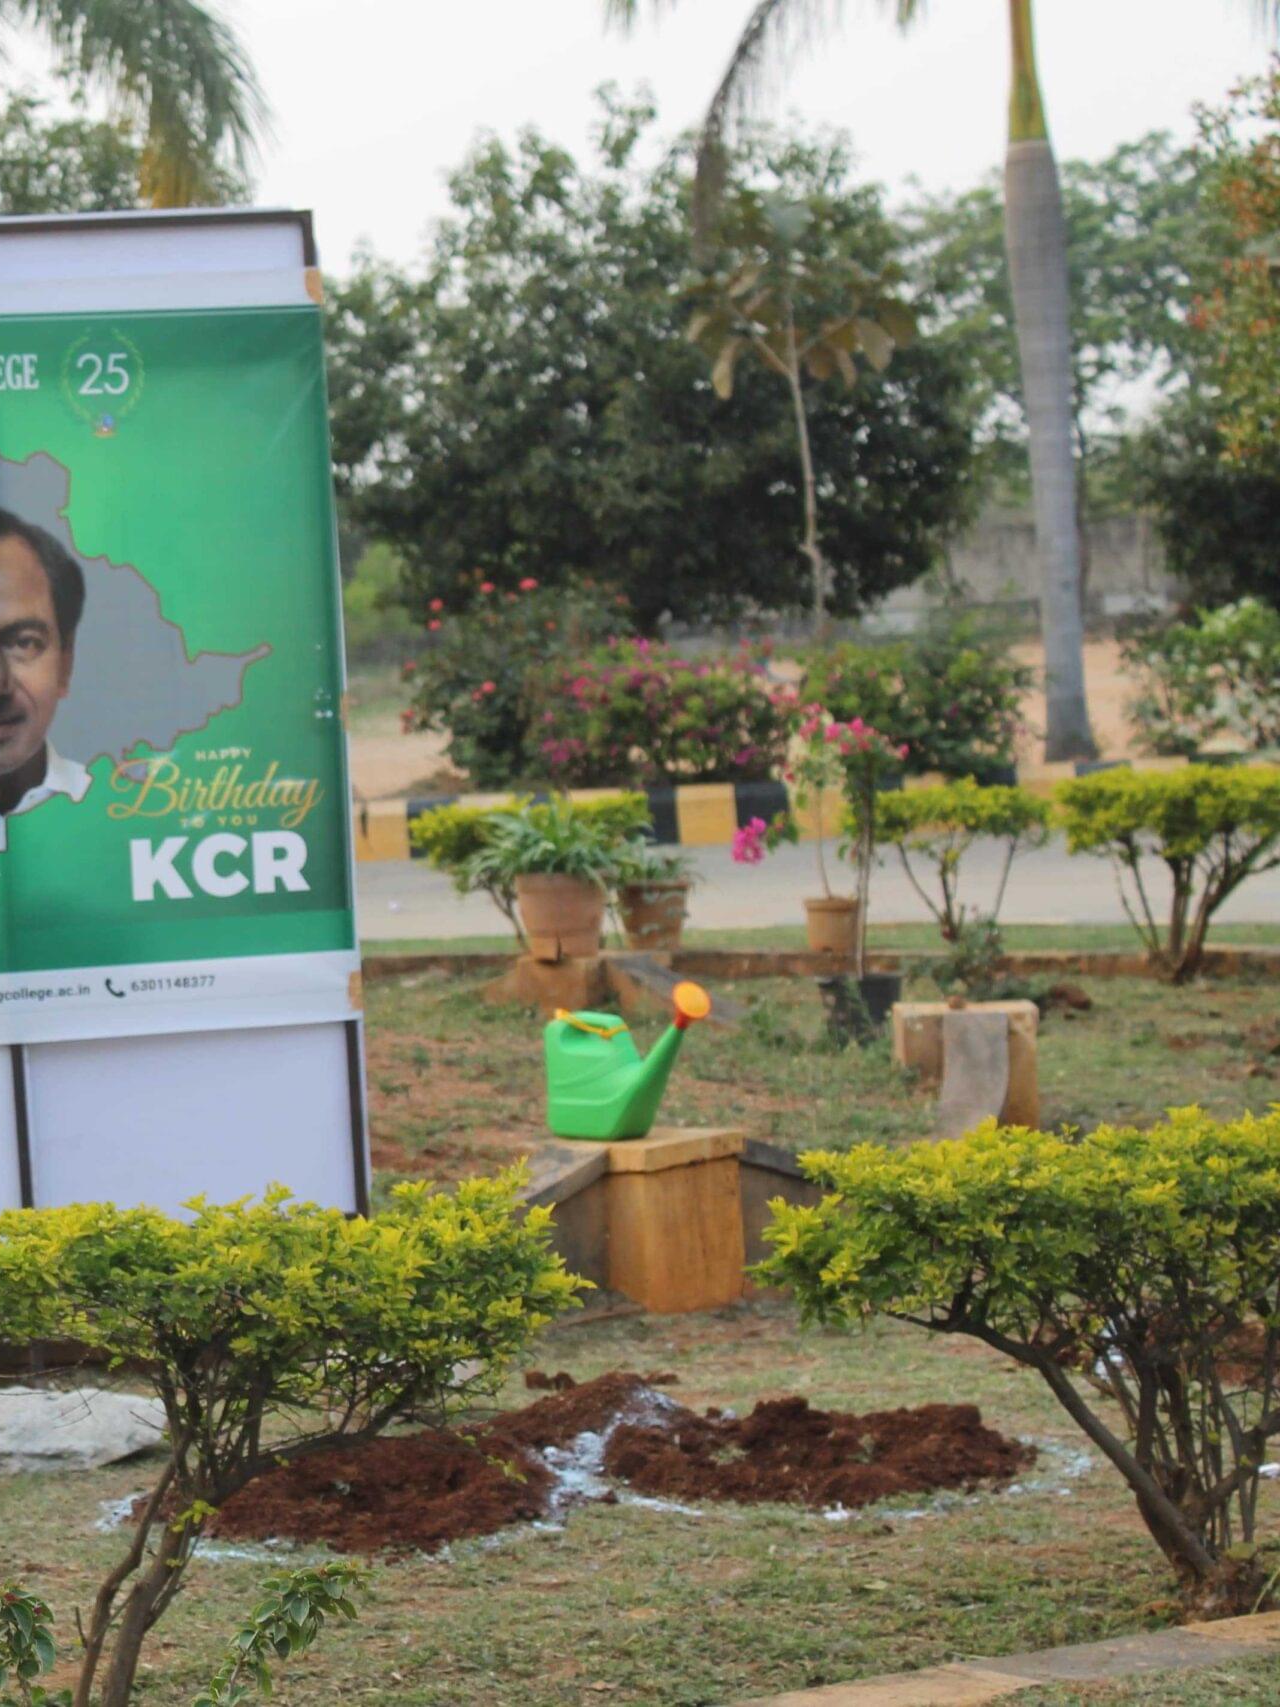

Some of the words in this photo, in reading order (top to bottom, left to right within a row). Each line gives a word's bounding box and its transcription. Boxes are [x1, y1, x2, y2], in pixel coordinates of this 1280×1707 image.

[77, 353, 129, 395] 25
[195, 746, 252, 762] HAPPY
[107, 755, 325, 828] Birthday
[129, 830, 311, 901] KCR
